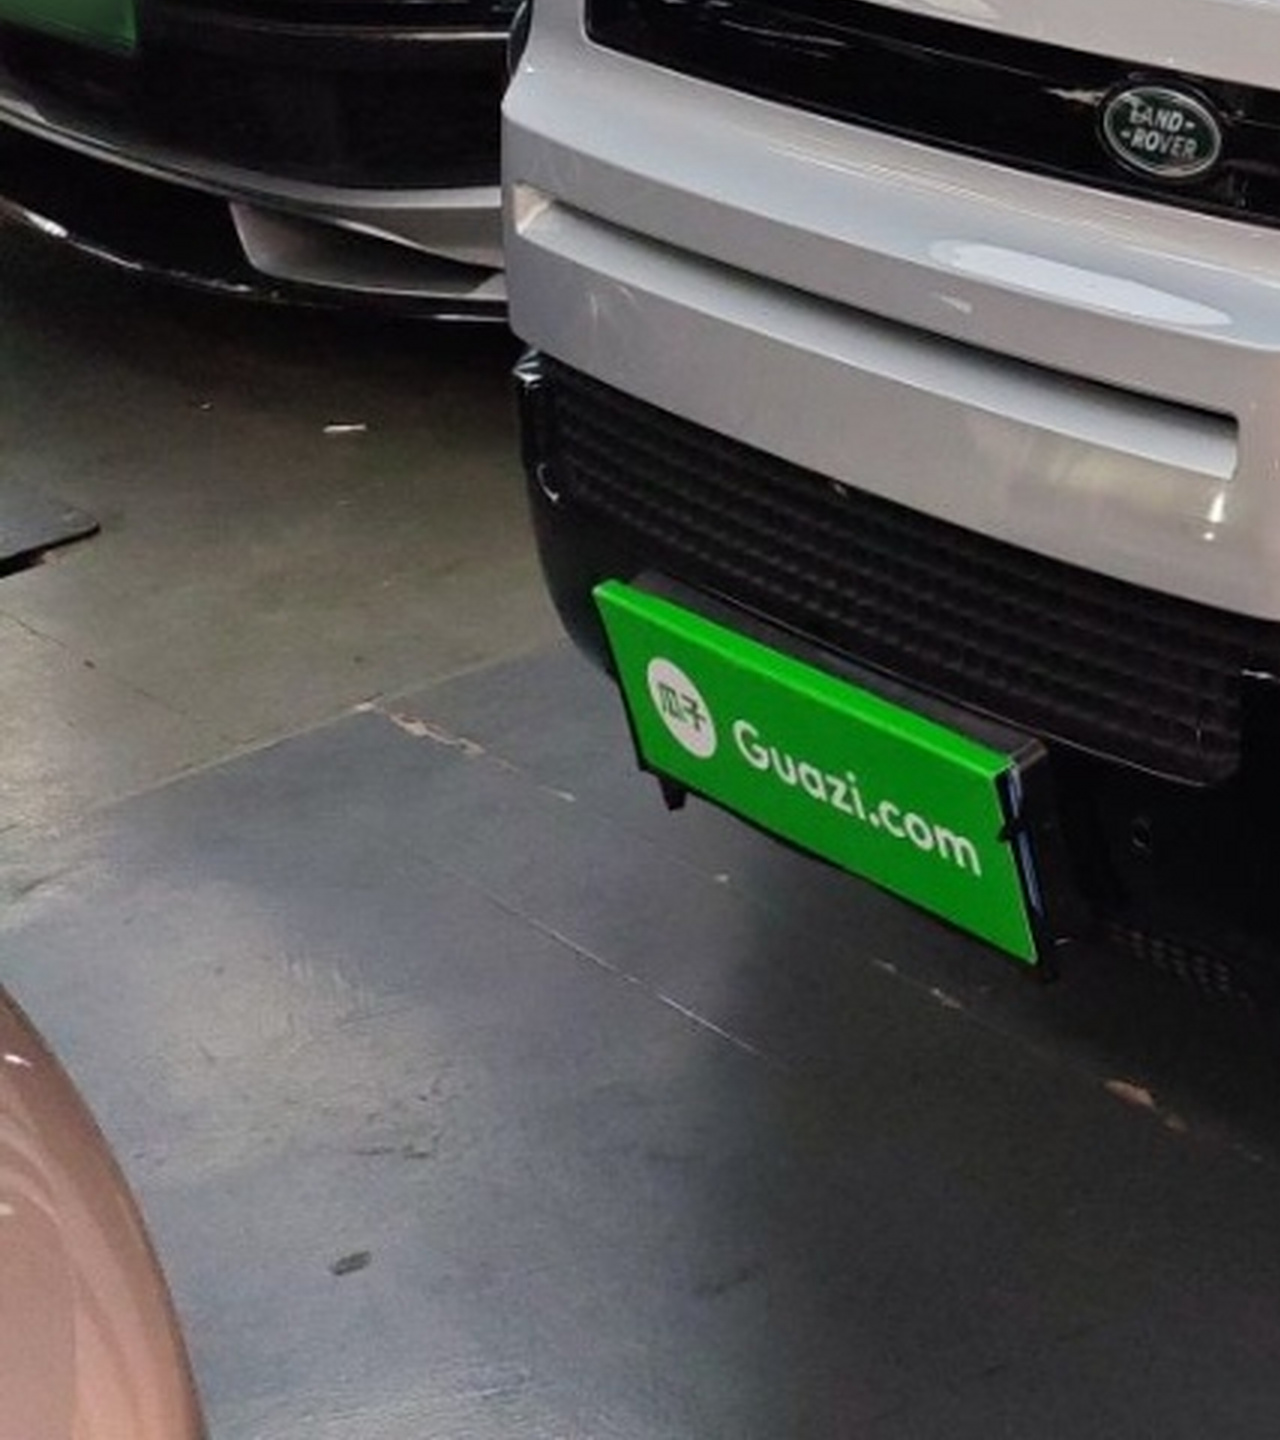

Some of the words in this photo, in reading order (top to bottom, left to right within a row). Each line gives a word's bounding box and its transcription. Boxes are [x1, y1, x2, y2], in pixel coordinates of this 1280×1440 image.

[1129, 105, 1184, 132] LAND
[1130, 128, 1198, 159] ROVER
[732, 719, 982, 877] Guazi.com
